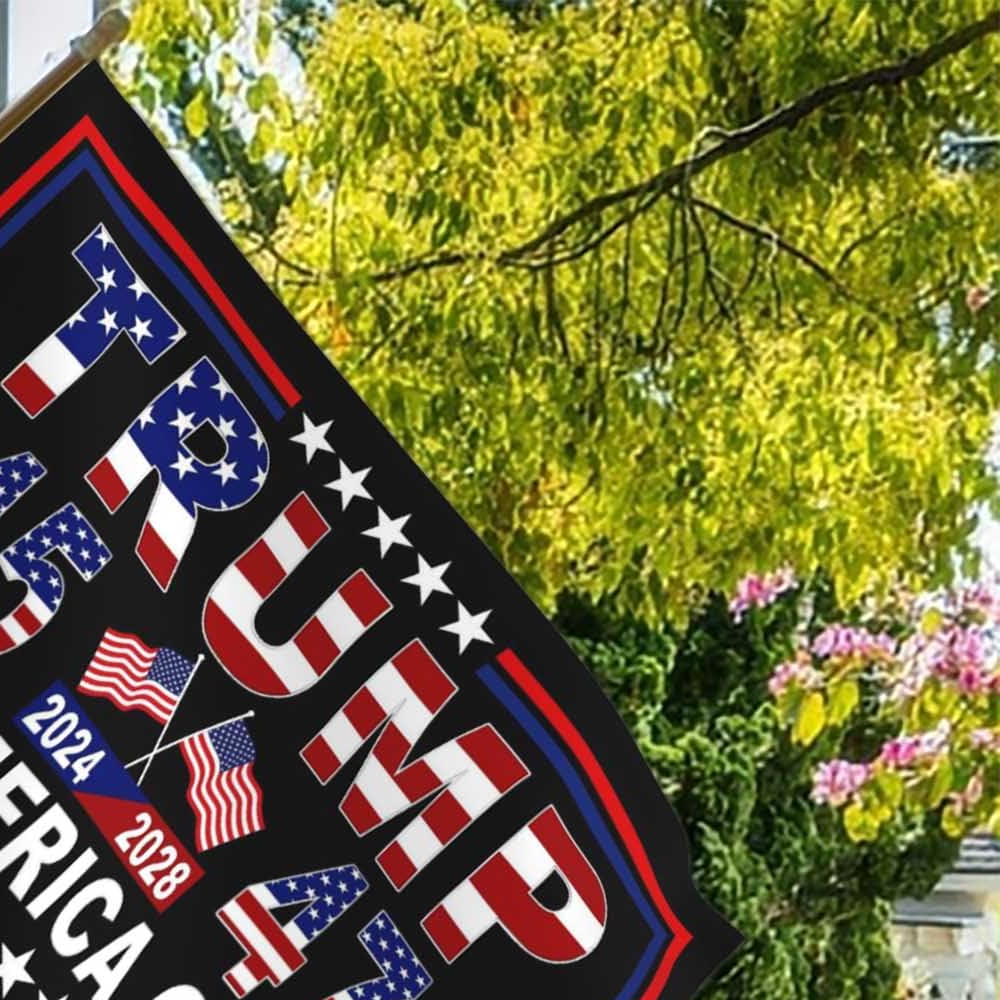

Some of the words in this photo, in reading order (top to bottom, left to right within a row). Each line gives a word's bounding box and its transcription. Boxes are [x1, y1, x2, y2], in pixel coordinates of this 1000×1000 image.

[1, 222, 608, 964] TRUMP
[20, 693, 106, 786] 2024
[114, 812, 192, 901] 2028
